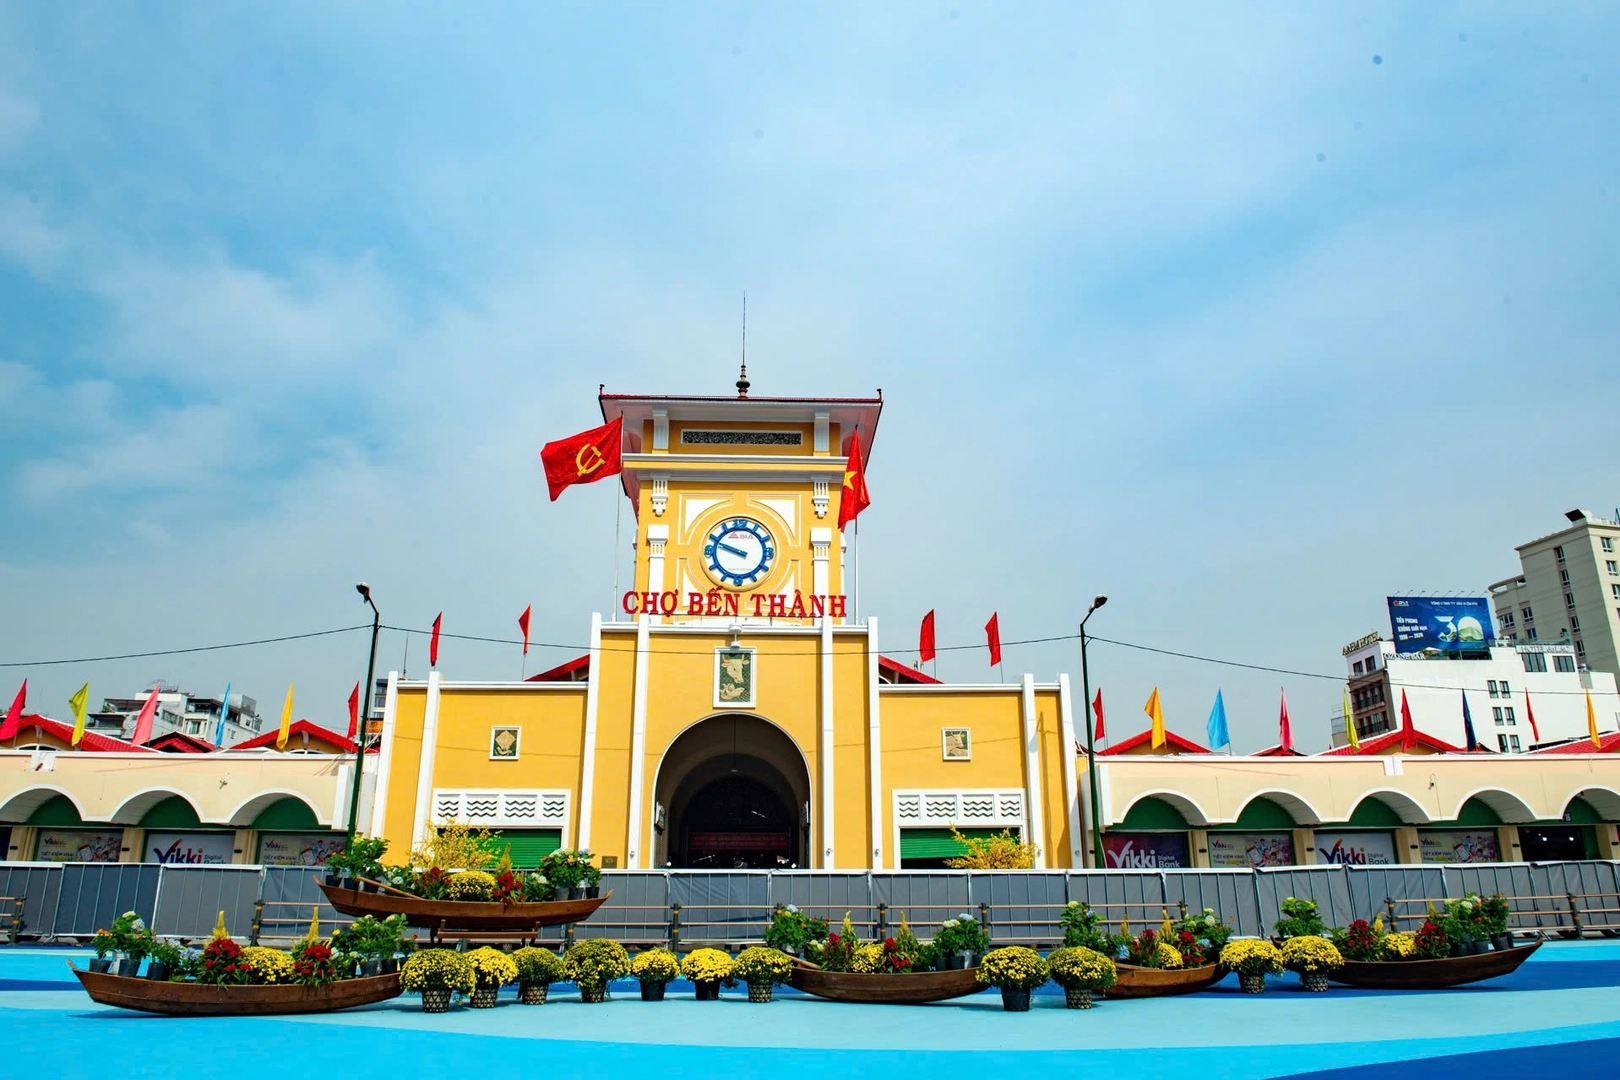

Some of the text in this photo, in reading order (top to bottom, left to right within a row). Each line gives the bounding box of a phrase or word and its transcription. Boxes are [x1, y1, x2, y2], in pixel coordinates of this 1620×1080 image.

[622, 585, 848, 618] CHỢ BẾN THÀNH
[153, 839, 203, 864] Vikki
[1107, 840, 1156, 868] Vikki
[1158, 860, 1180, 868] Bank
[1319, 838, 1366, 864] Vikki
